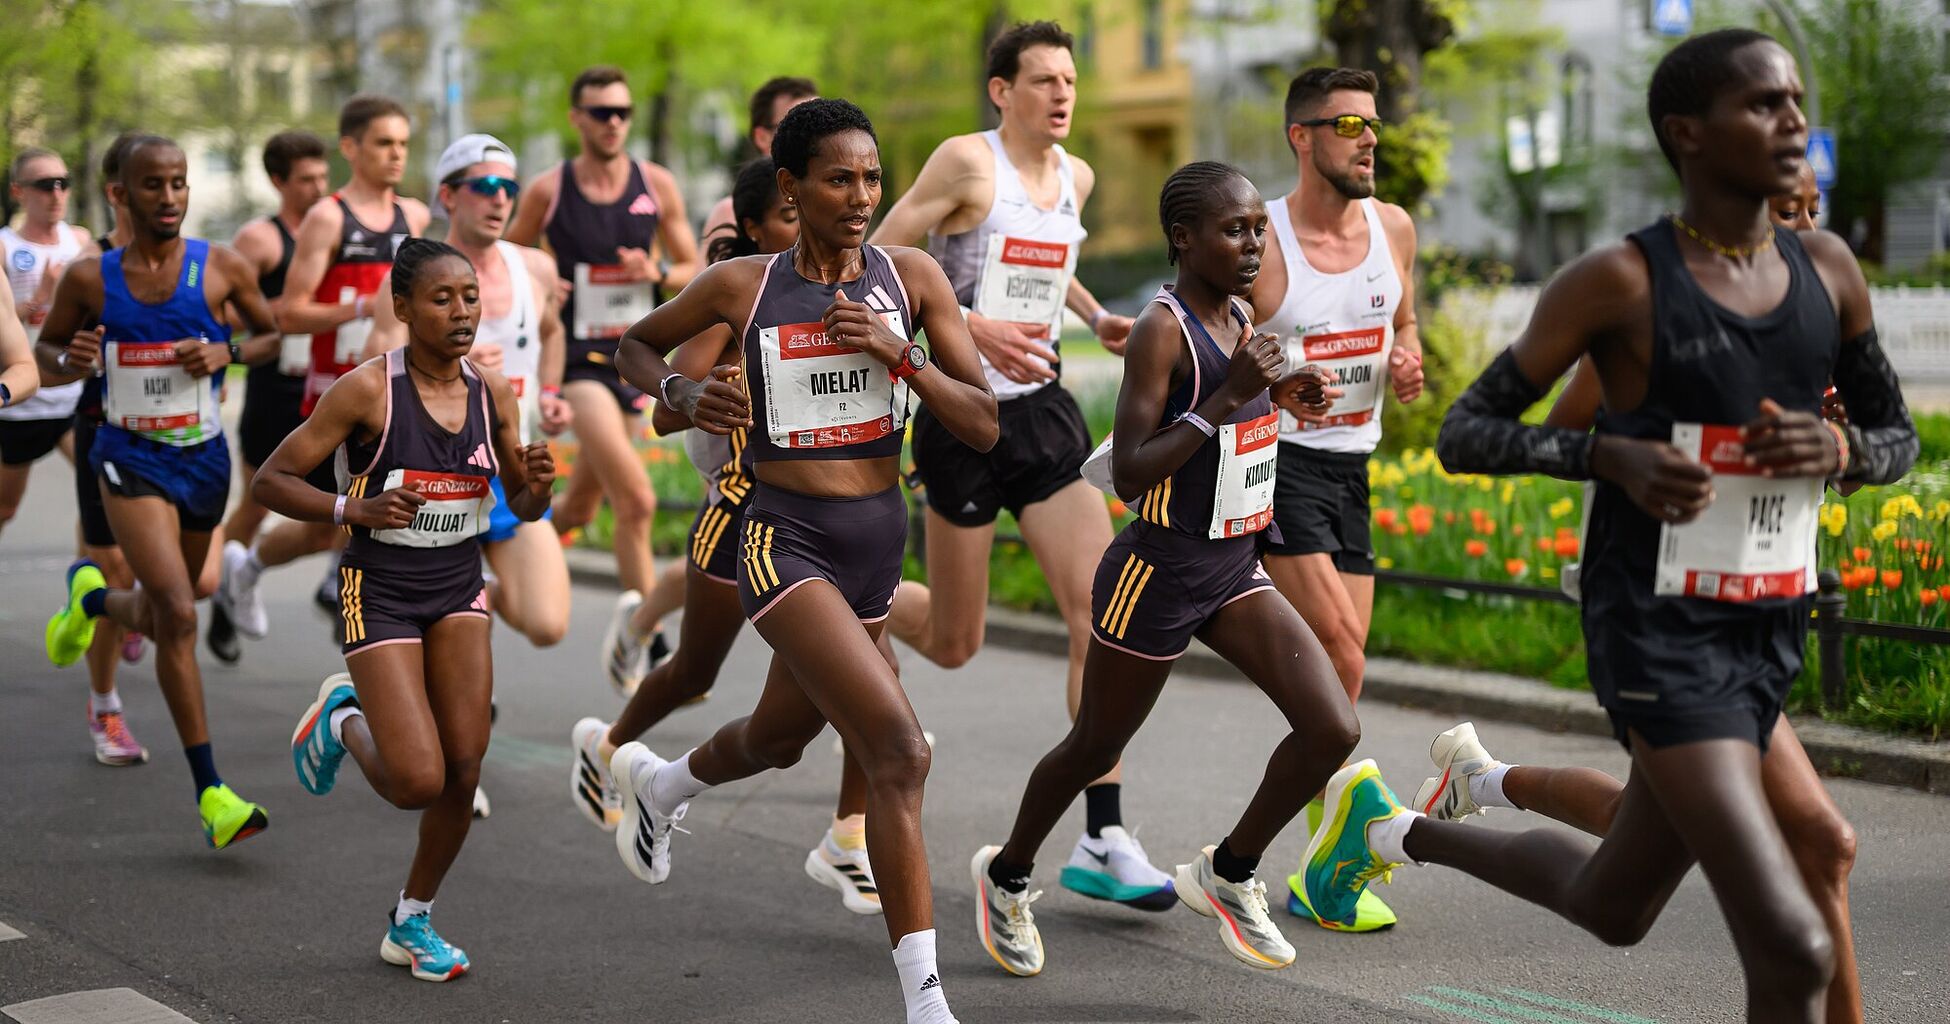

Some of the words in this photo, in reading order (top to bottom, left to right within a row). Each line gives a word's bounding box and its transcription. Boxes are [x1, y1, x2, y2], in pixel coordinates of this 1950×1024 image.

[811, 368, 870, 396] MELAT
[839, 402, 847, 411] F2
[1748, 495, 1785, 534] PACE
